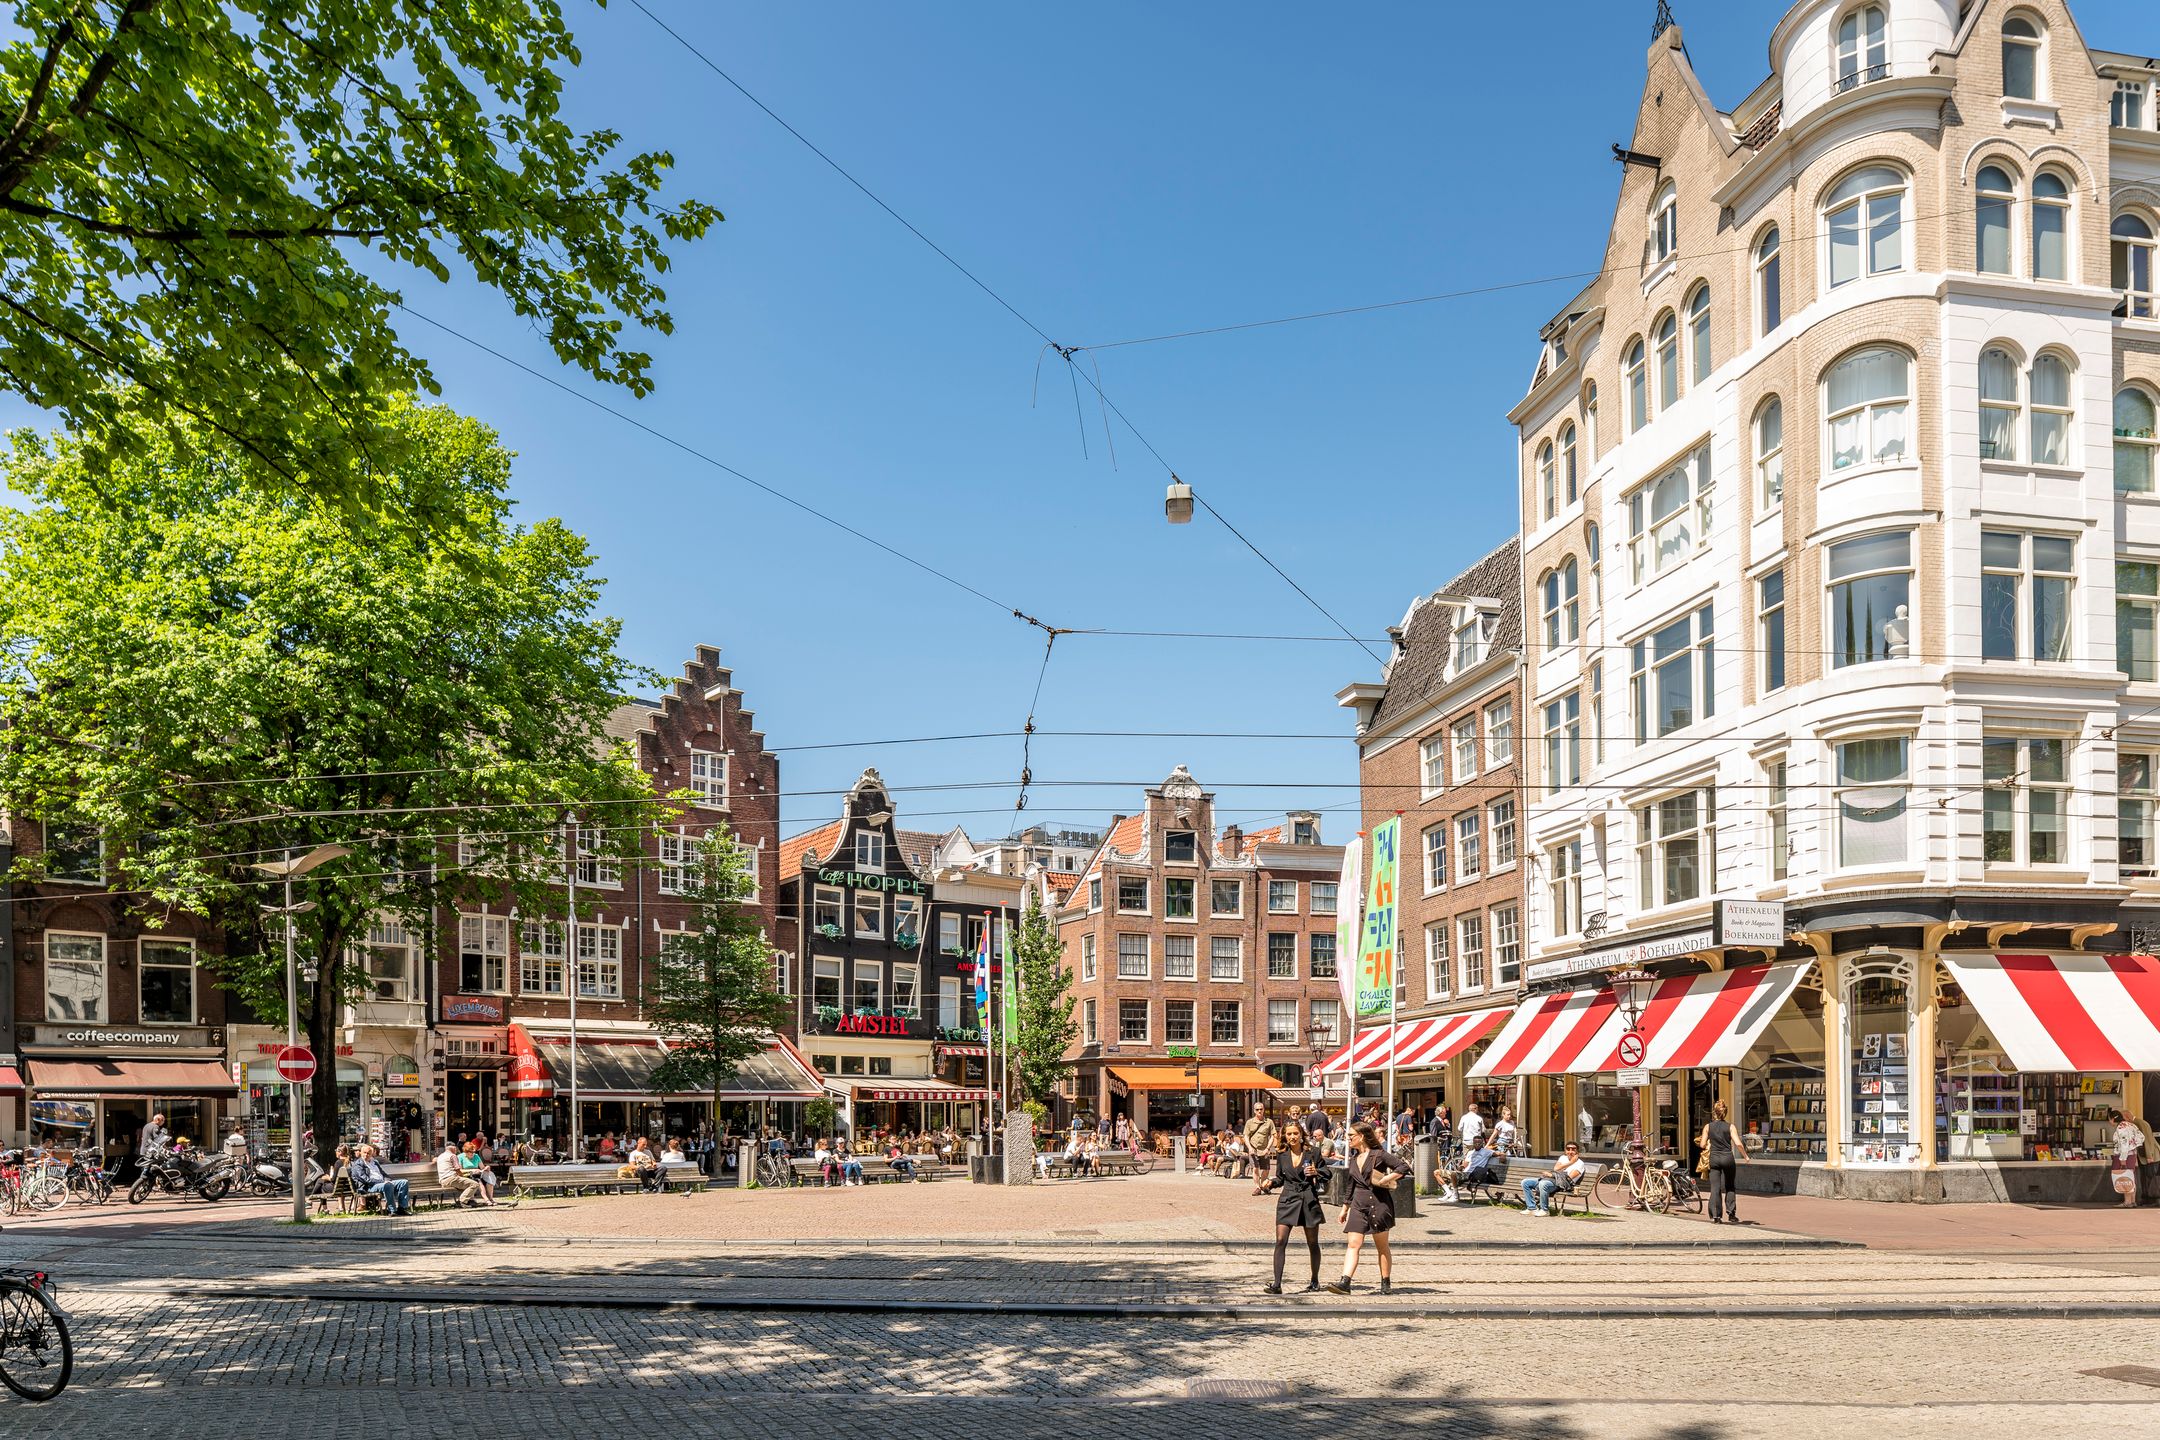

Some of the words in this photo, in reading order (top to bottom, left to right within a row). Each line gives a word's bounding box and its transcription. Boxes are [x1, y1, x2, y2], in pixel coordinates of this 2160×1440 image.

[818, 867, 845, 886] Café
[847, 872, 926, 896] HOPPE
[1727, 904, 1780, 915] ATHENAEUM
[1751, 920, 1775, 928] Magazines
[1724, 930, 1781, 940] BOEKHANDEL
[1566, 953, 1621, 973] ATHENAEUM
[1640, 937, 1712, 960] BOEKHANDEL
[447, 1003, 500, 1018] LUXEMBOURG
[835, 1013, 909, 1035] AMSTEL
[66, 1030, 180, 1044] coffeecompany
